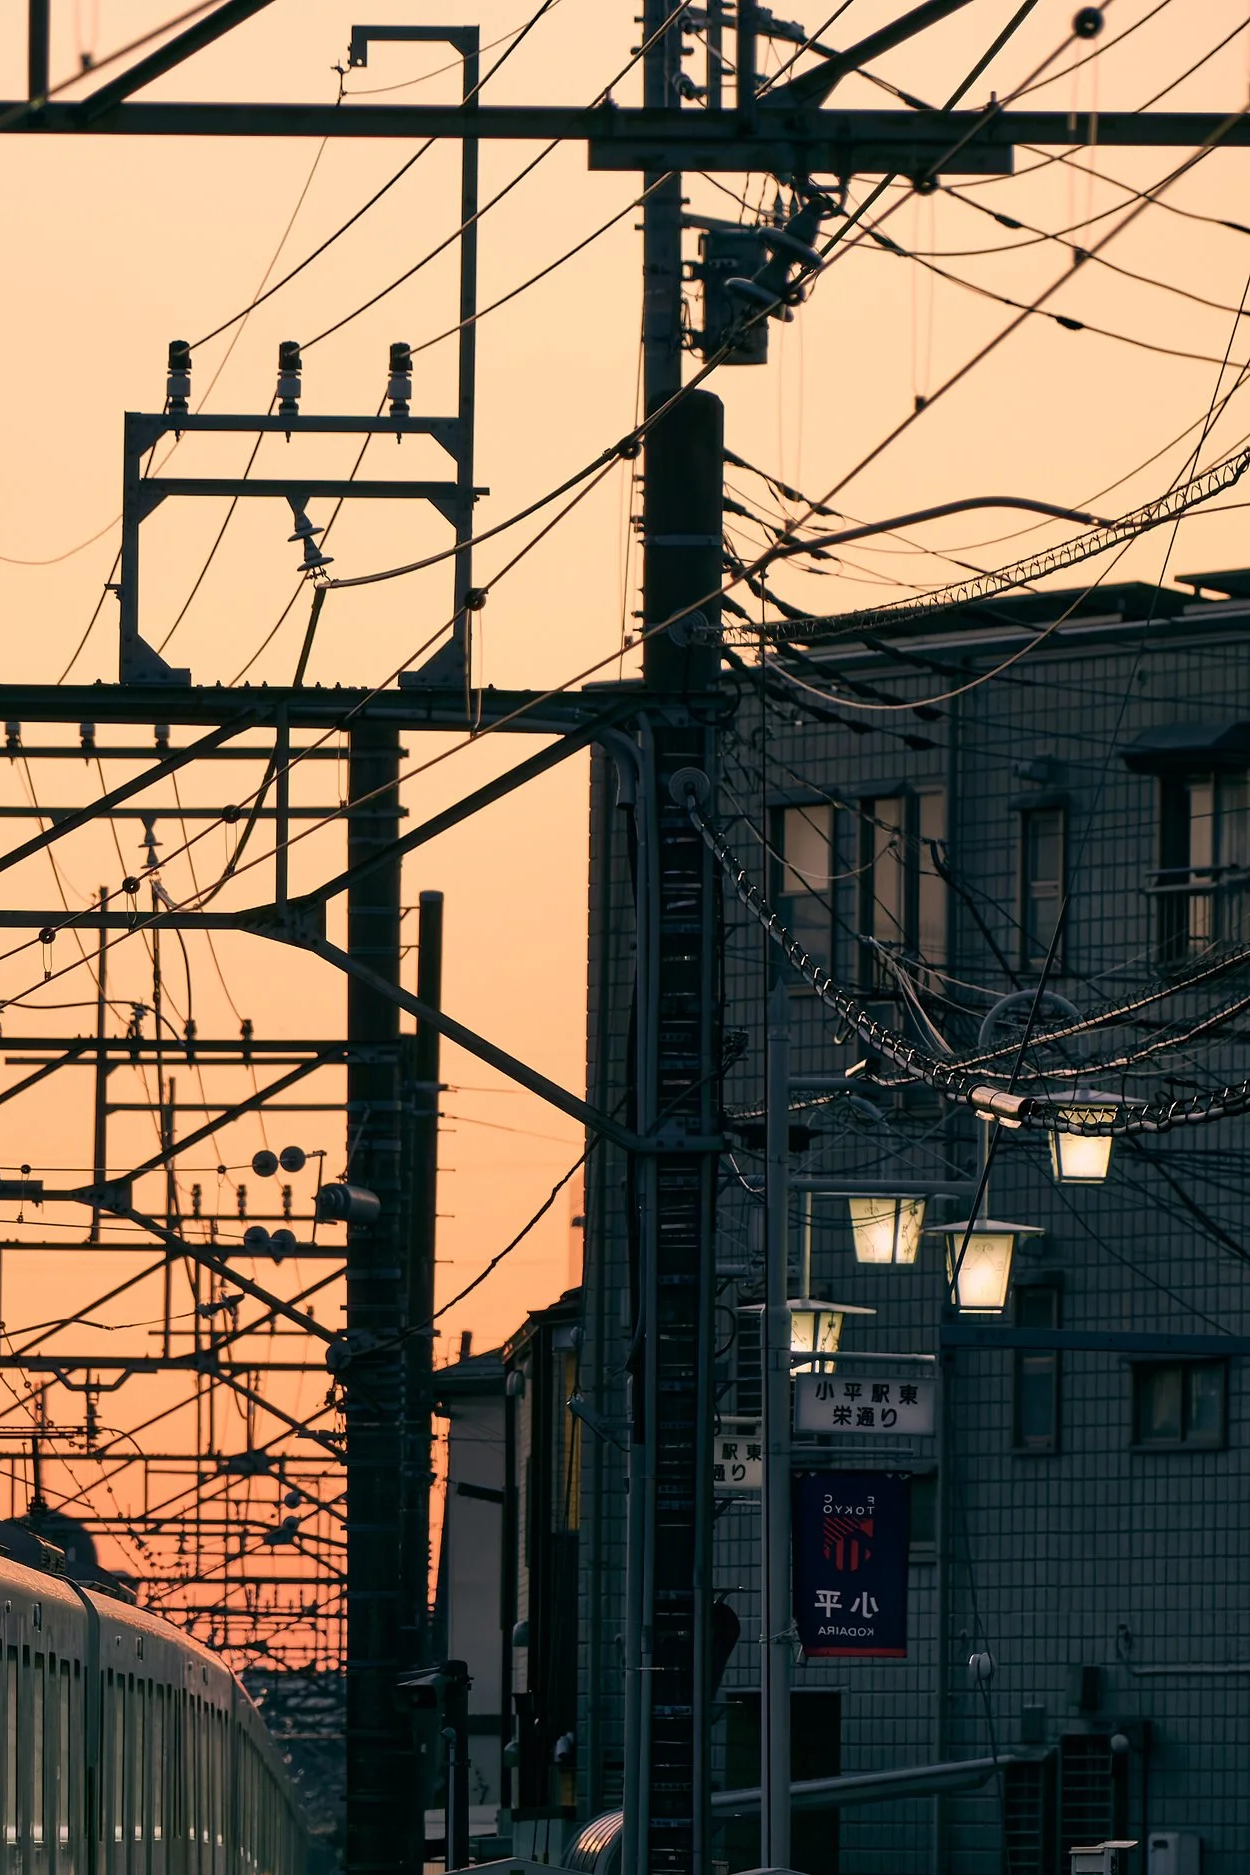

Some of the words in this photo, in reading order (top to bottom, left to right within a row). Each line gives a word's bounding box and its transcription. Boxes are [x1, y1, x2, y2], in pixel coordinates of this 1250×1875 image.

[815, 1381, 919, 1405] 小平駅東
[833, 1405, 898, 1428] 栄通り
